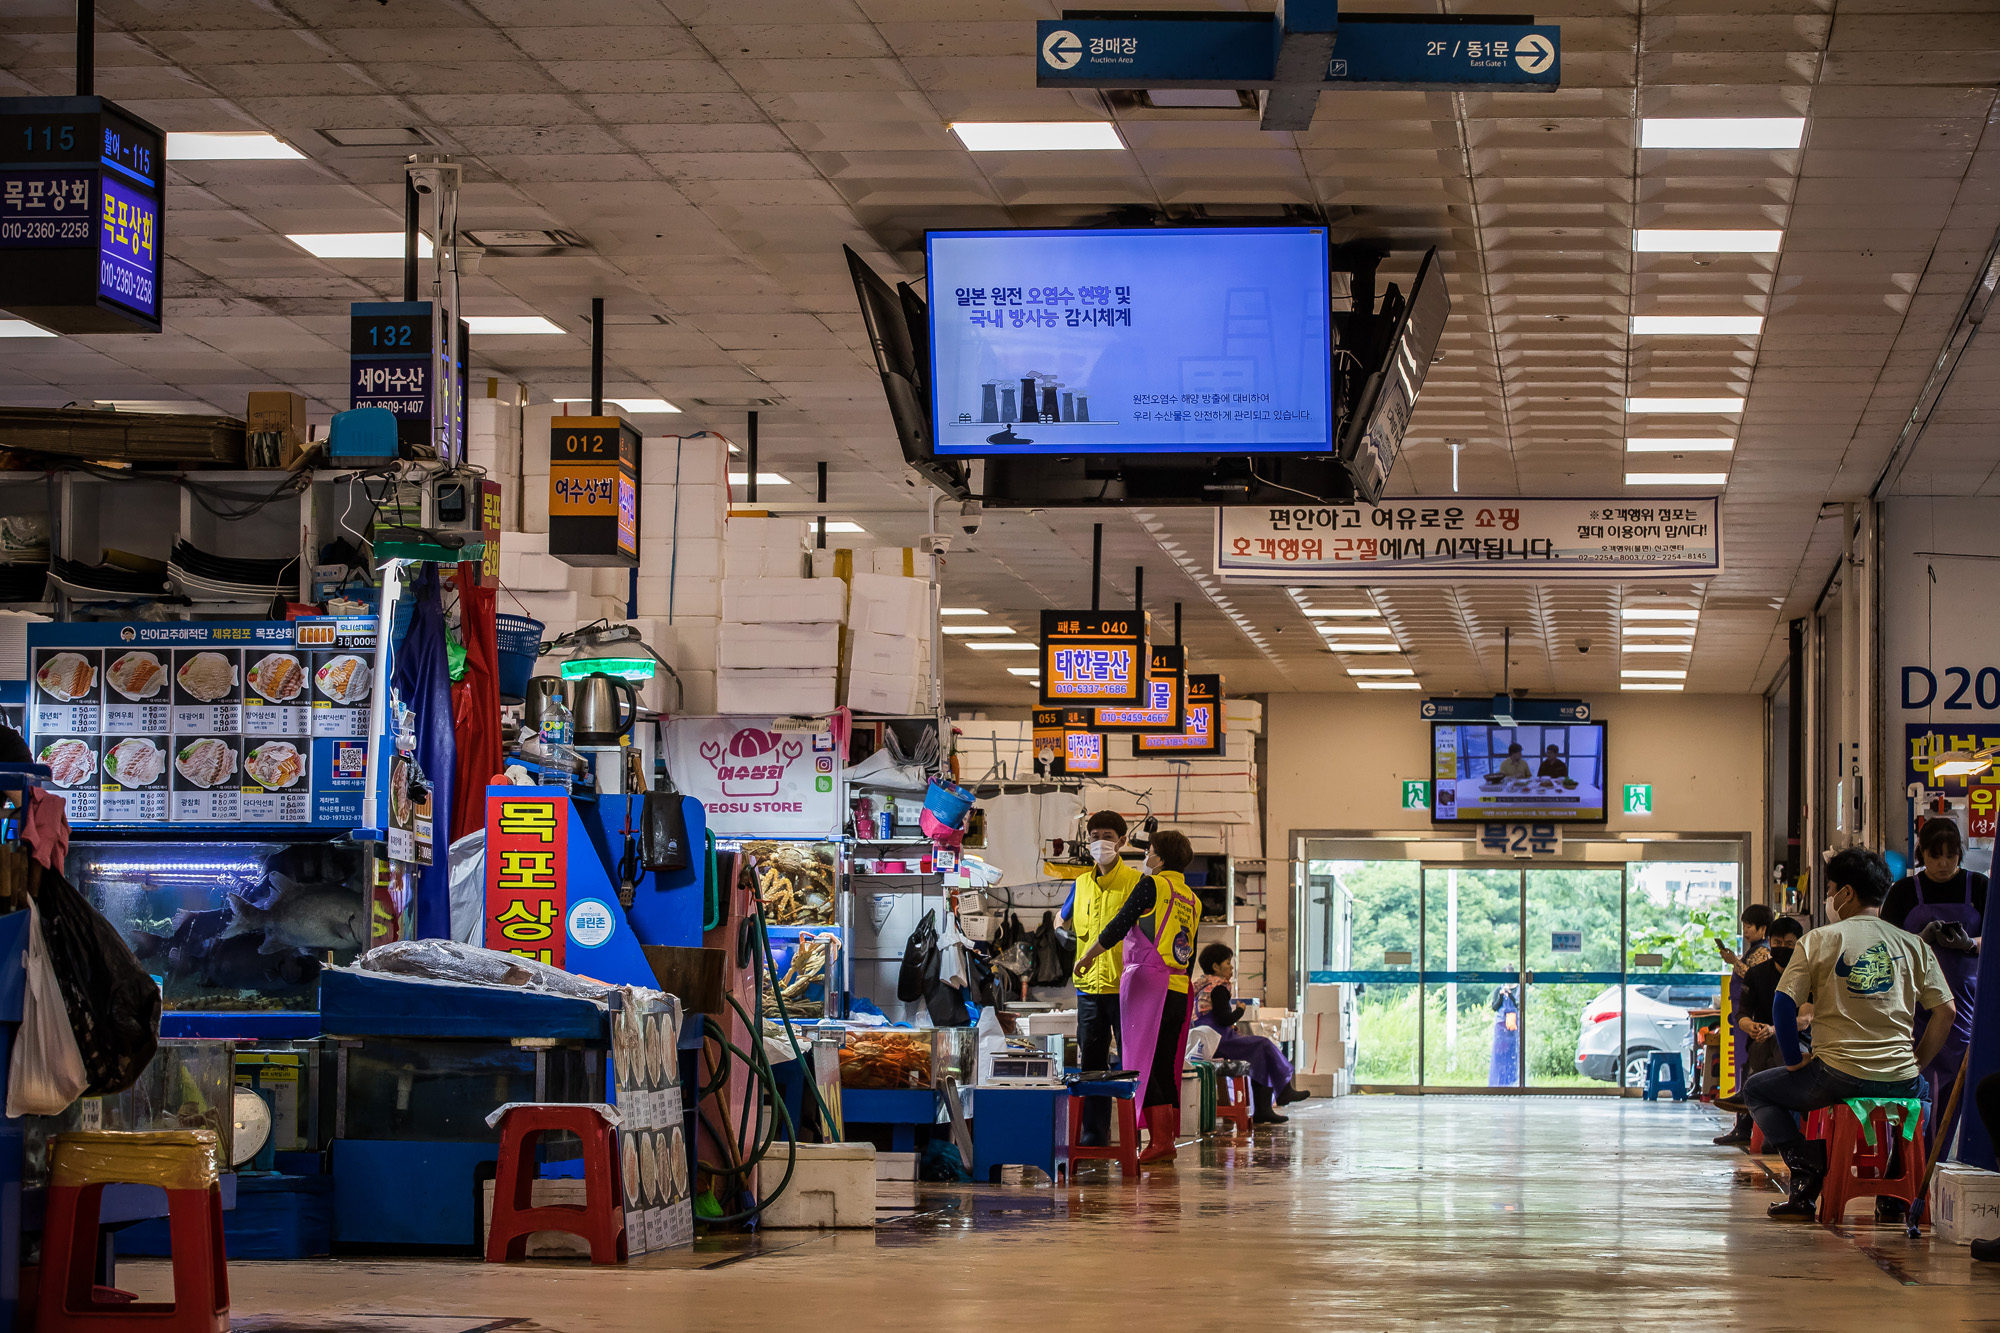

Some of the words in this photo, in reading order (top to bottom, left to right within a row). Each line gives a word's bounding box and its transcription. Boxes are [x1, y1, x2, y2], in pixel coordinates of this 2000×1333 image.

[1089, 37, 1138, 54] 경매장
[1427, 41, 1447, 56] 2F
[1452, 40, 1461, 58] /
[1467, 41, 1510, 58] 동1문
[24, 126, 75, 151] 115
[104, 127, 120, 161] 활어
[133, 143, 150, 175] 115
[4, 179, 90, 211] 목포상회
[2, 222, 89, 239] 010-2360-2258
[103, 192, 153, 261] 목포상회
[101, 260, 153, 305] 010-2360-2258
[955, 287, 987, 306] 일본
[990, 286, 1022, 306] 원전
[1026, 286, 1075, 306] 오염수
[1078, 286, 1111, 306] 현황
[1115, 285, 1131, 305] 및
[969, 308, 1003, 328] 국내
[1008, 308, 1059, 328] 방사능
[1065, 307, 1132, 328] 감시체계
[369, 325, 412, 346] 132
[357, 367, 424, 392] 세아수산
[1132, 394, 1178, 405] 원전오염수
[1181, 393, 1199, 404] 해양
[1201, 393, 1230, 404] 방출에
[1233, 393, 1270, 404] 대비하여
[1133, 411, 1151, 422] 우리
[1154, 410, 1192, 422] 수산물은
[1194, 410, 1232, 421] 안전하게
[1234, 410, 1271, 420] 관리되고
[1273, 409, 1313, 420] 있습니다.
[566, 435, 604, 453] 012
[555, 478, 614, 505] 여수상회
[1268, 508, 1362, 531] 편안하고
[1371, 507, 1464, 531] 여유로운
[1475, 508, 1520, 531] 쇼핑
[1658, 508, 1698, 522] 점포는
[1577, 525, 1604, 539] 절대
[1607, 525, 1660, 539] 이용하지
[1664, 524, 1708, 539] 맙시다!
[1231, 536, 1323, 562] 호객행위
[1333, 537, 1425, 561] 근절에서
[1435, 537, 1560, 561] 시작됩니다.
[1646, 552, 1707, 561] 02-2254-8145
[140, 629, 208, 640] 인어교주해적단
[212, 628, 251, 640] 제휴점포
[256, 628, 294, 640] 목포상회
[1057, 621, 1081, 634] 패류
[1101, 621, 1128, 634] 040
[1054, 649, 1130, 681] 태한물산
[1056, 684, 1127, 694] 010-5337-1686
[1038, 713, 1056, 724] 055
[1100, 712, 1169, 723] 010-9459-4667
[1067, 734, 1100, 759] 미정상회
[718, 765, 785, 781] 여수상회
[753, 802, 803, 813] STORE
[576, 917, 606, 929] 클린존
